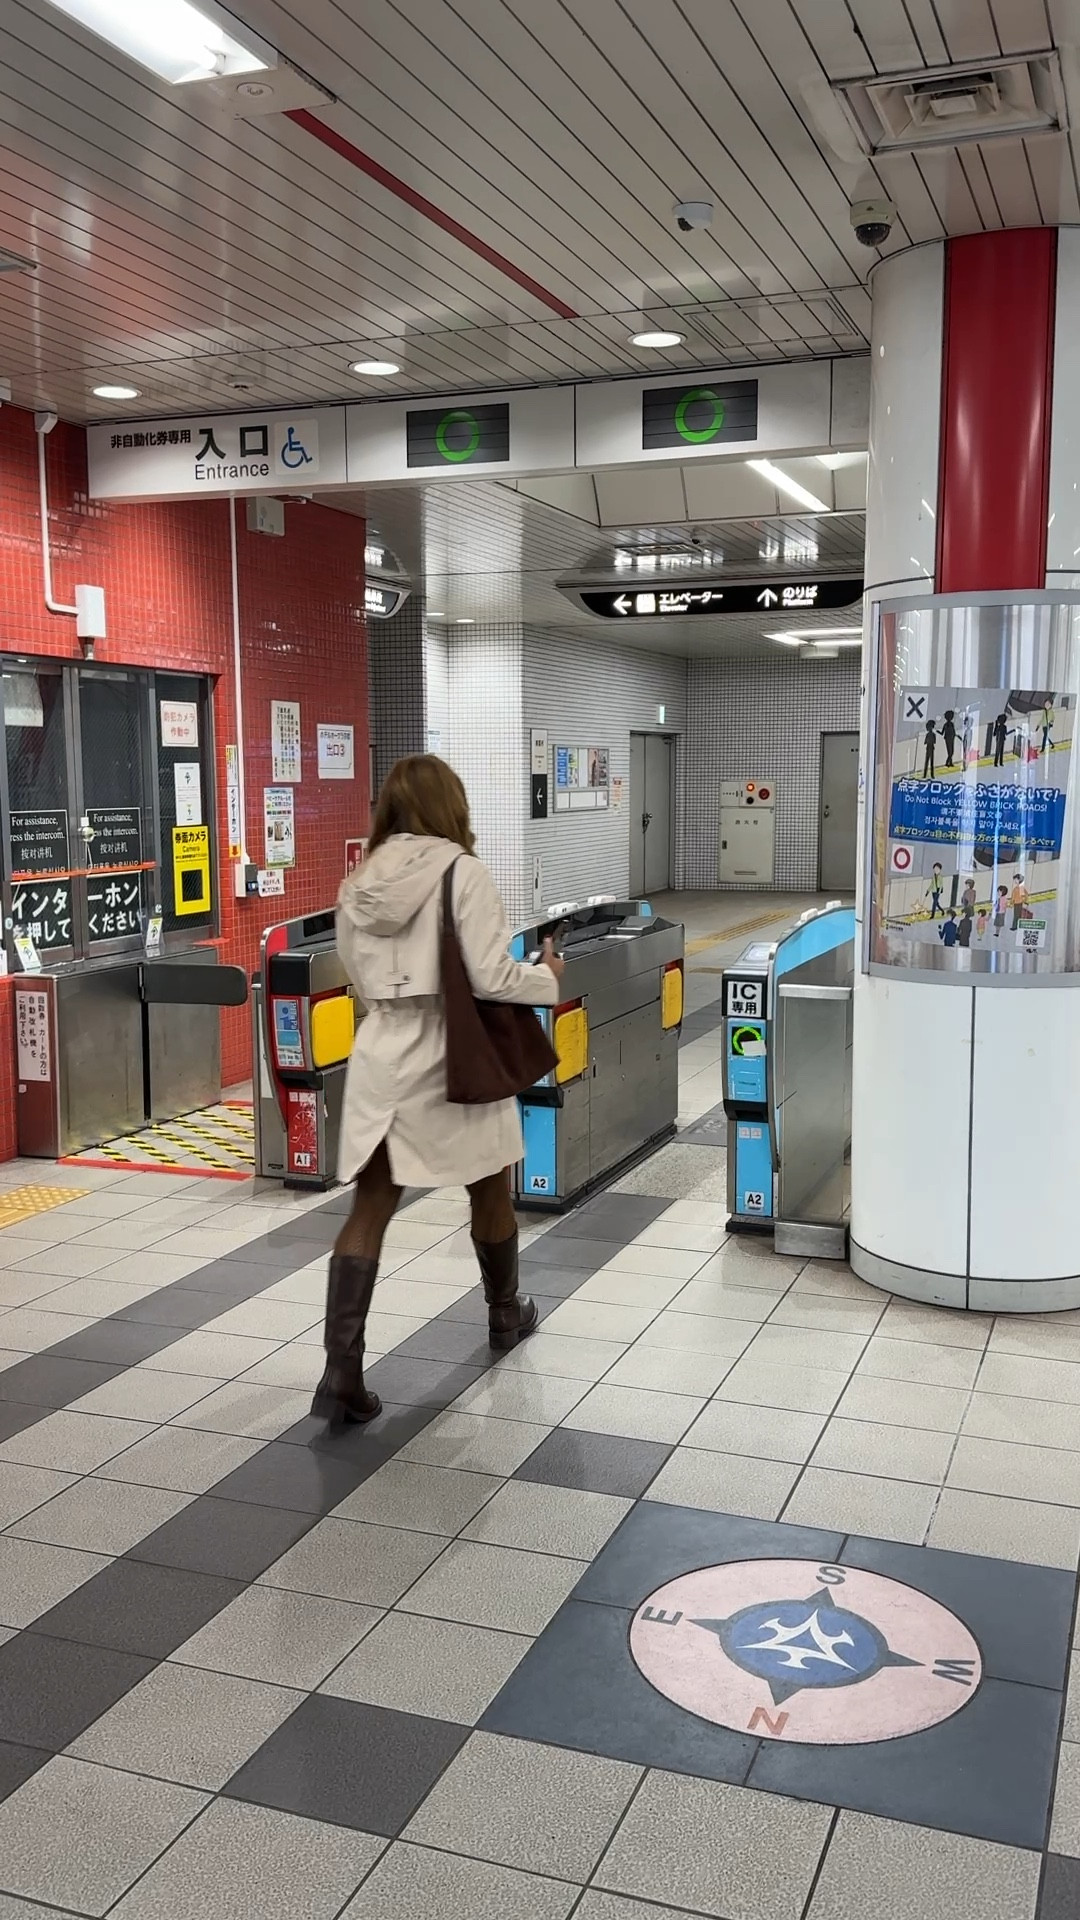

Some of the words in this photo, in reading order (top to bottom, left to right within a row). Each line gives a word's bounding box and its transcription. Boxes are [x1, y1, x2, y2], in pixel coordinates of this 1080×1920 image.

[110, 429, 191, 449] 非自動化券専用
[195, 425, 268, 461] 入口
[195, 463, 270, 480] Entrance
[659, 591, 724, 604] エレベーター
[782, 585, 818, 599] のりば
[905, 794, 915, 803] Do
[916, 795, 930, 804] Not
[931, 796, 952, 806] Block
[954, 798, 988, 808] YELLOW
[990, 802, 1015, 811] BRICK
[12, 816, 23, 827] For
[25, 815, 58, 826] assistance,
[93, 813, 103, 823] For
[104, 813, 133, 823] assistance,
[10, 833, 23, 842] ress
[24, 832, 35, 841] the
[36, 830, 66, 841] intercom.
[103, 827, 112, 837] the
[113, 826, 139, 836] intercom.
[732, 984, 757, 1000] IC
[731, 1001, 757, 1015] 専用
[532, 1178, 547, 1189] A2
[747, 1194, 762, 1205] A2
[815, 1566, 846, 1585] S
[640, 1606, 684, 1626] E
[932, 1658, 976, 1687] W
[747, 1706, 790, 1736] N
